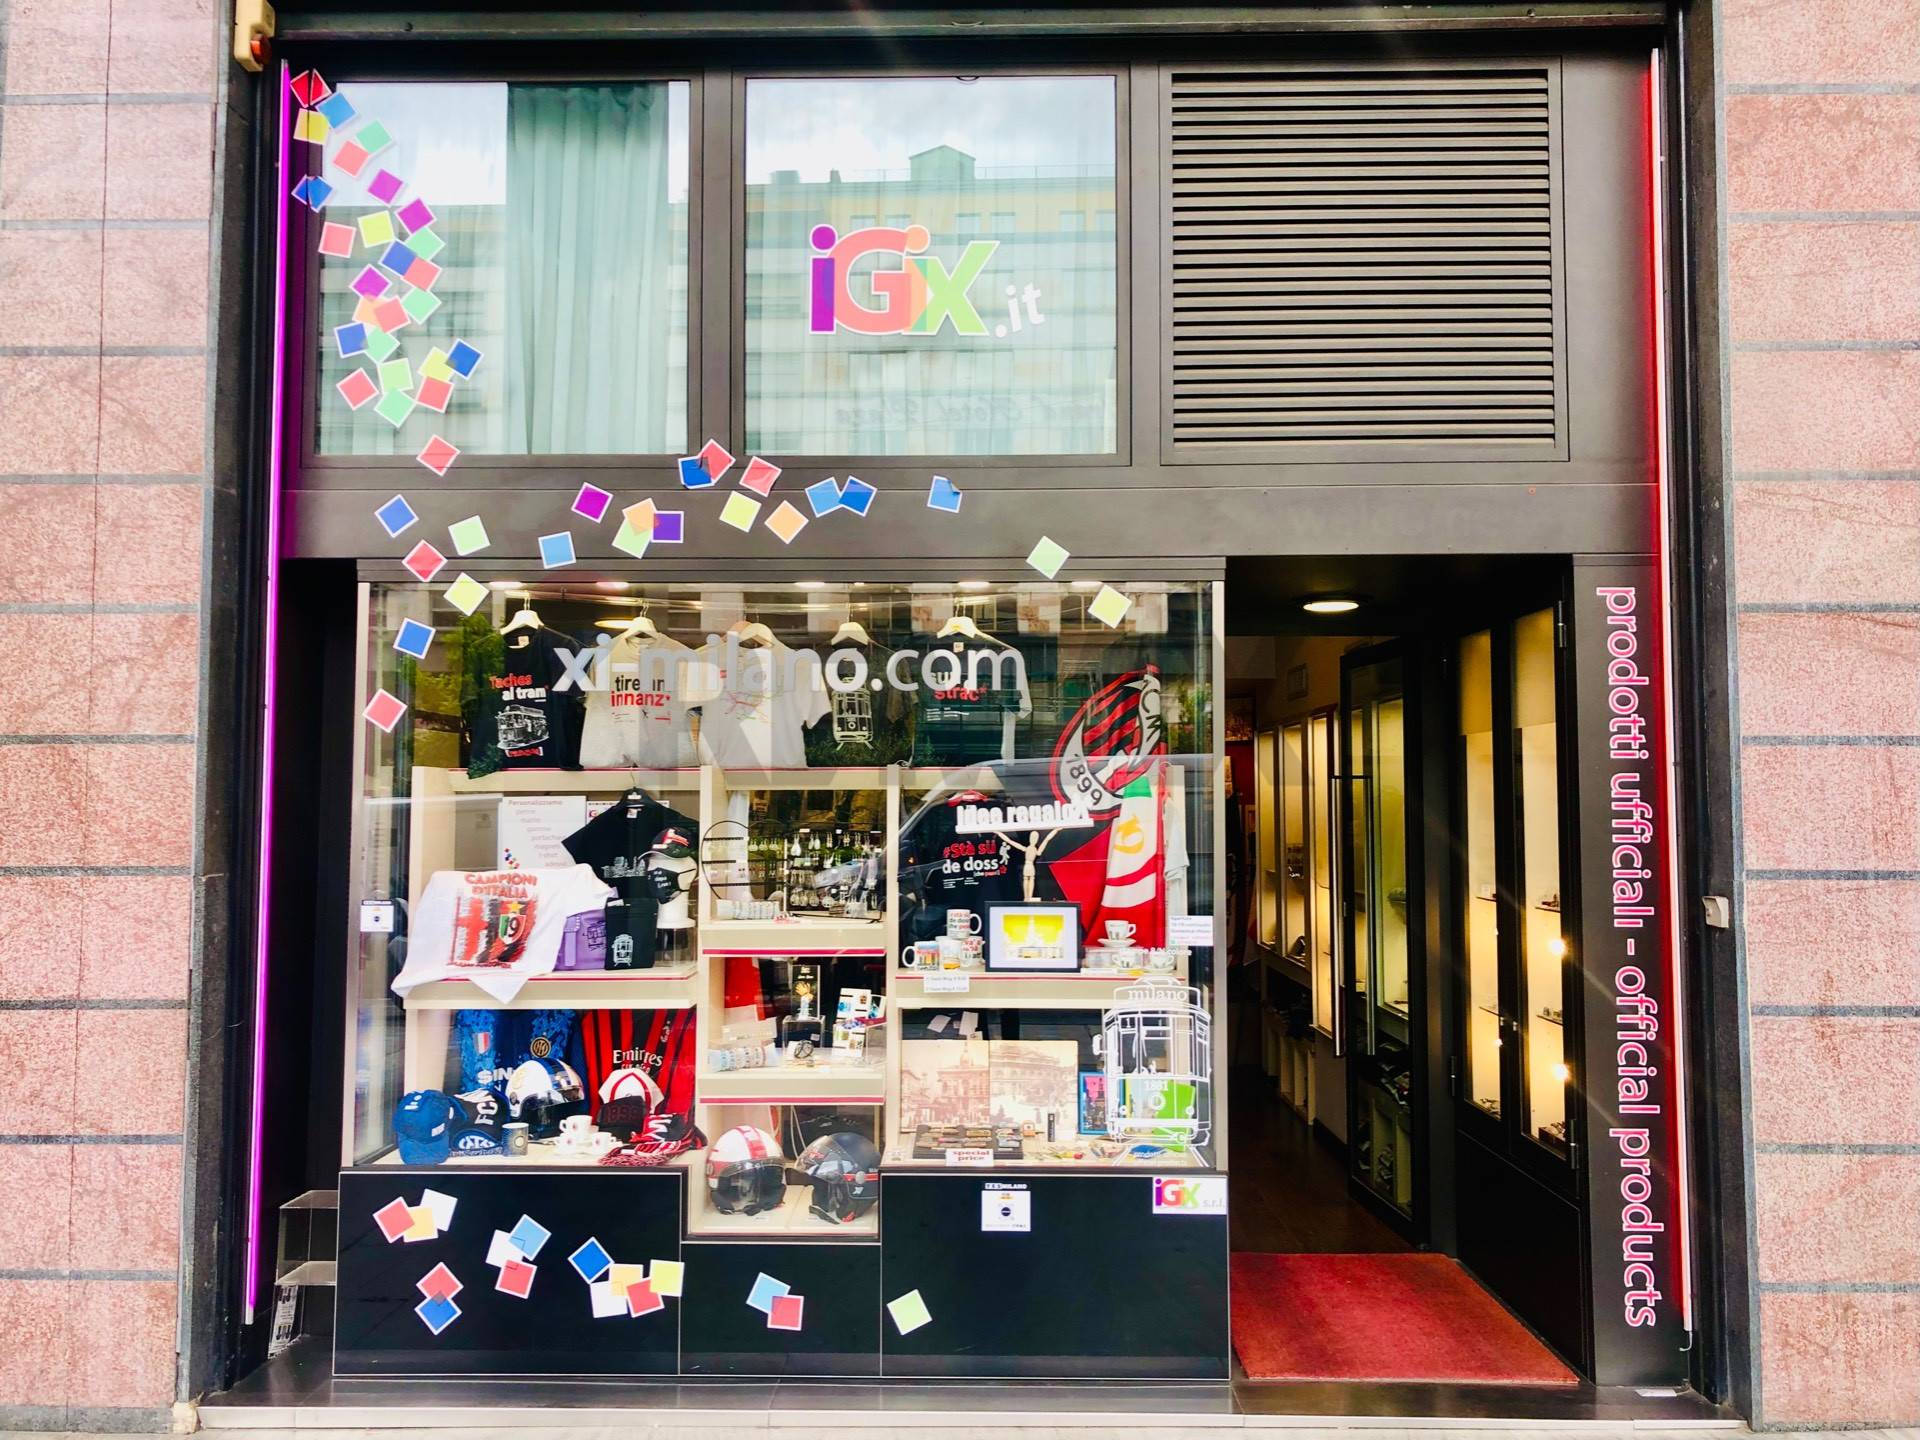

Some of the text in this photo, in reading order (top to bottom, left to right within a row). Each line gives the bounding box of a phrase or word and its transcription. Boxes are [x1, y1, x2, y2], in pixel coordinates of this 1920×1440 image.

[1596, 586, 1650, 760] prodotti
[1065, 753, 1103, 806] 1899
[942, 858, 961, 874] de
[963, 856, 999, 871] doss
[1610, 772, 1654, 928] ufficiali
[465, 872, 537, 886] CAMPIONI
[503, 915, 521, 938] 19
[1127, 985, 1188, 1001] milano
[1615, 965, 1660, 1114] official
[1609, 1127, 1664, 1328] products
